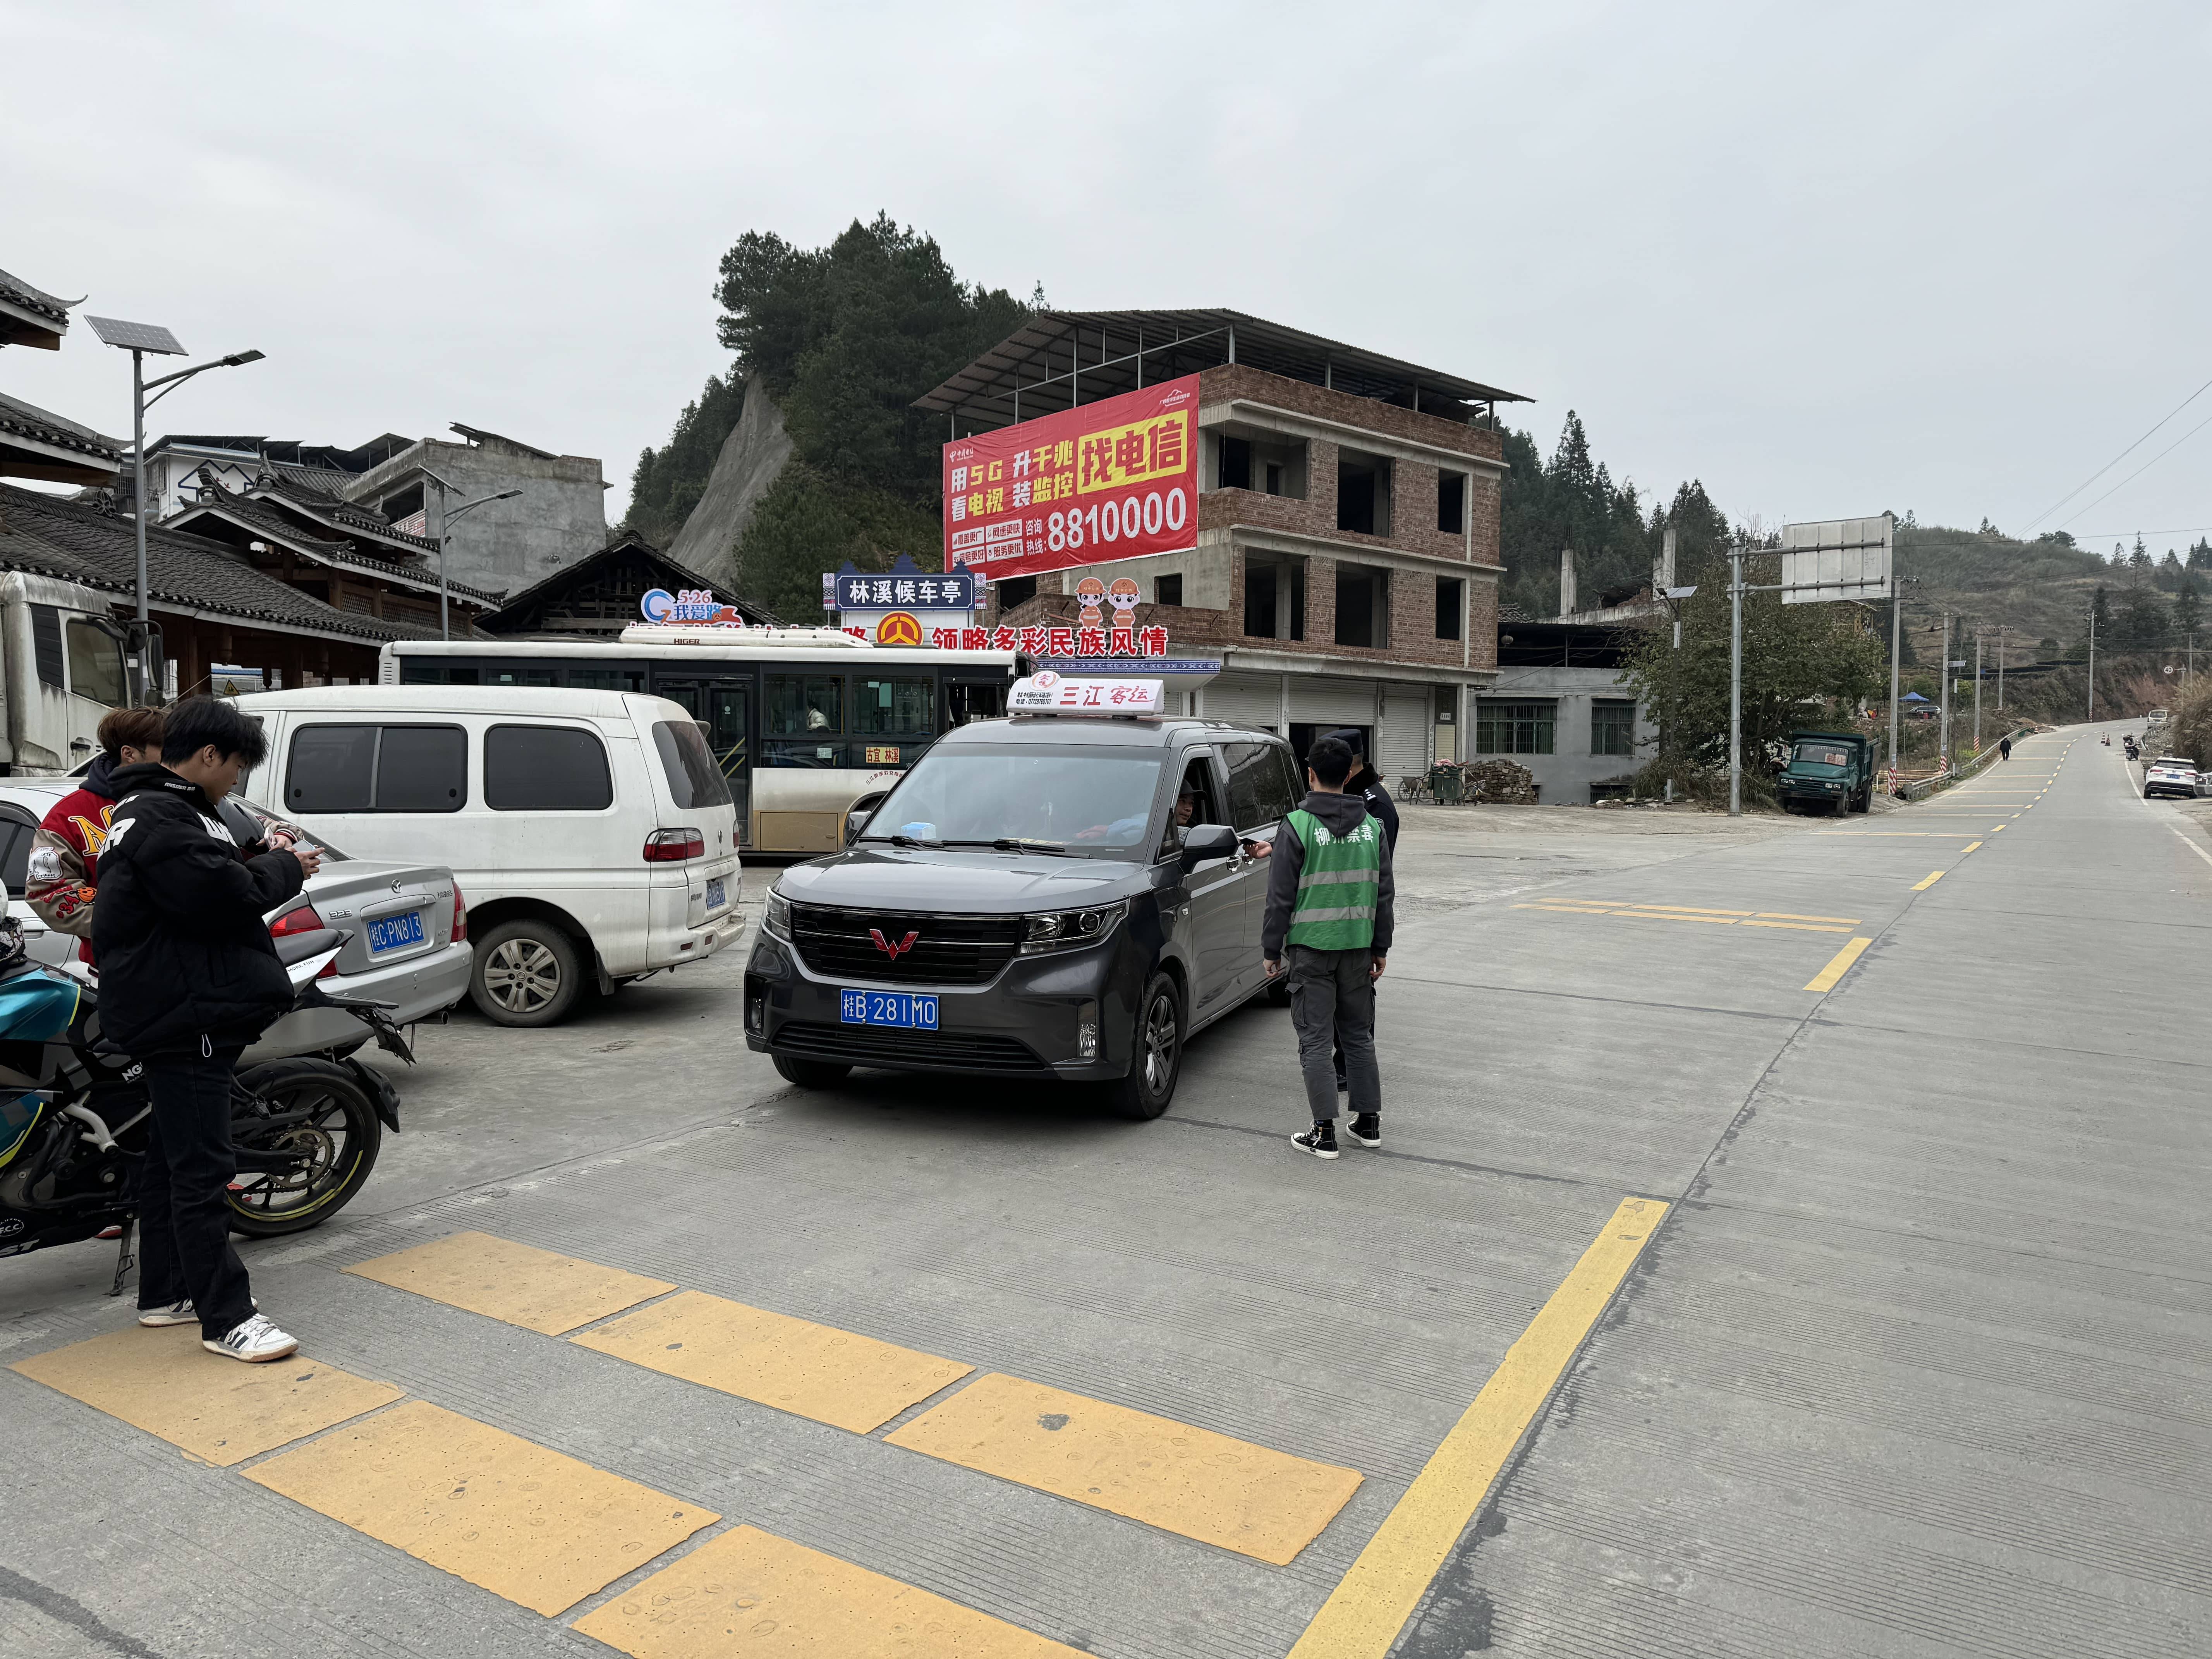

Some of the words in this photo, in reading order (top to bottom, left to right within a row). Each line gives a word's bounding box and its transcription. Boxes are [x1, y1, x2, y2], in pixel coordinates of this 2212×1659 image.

[1013, 440, 1073, 478] 升千兆
[1082, 420, 1183, 488] 找电信
[951, 487, 1003, 522] 看电视
[1012, 471, 1073, 508] 装监控
[1025, 518, 1042, 536] 咨询
[1048, 488, 1186, 551] 8810000
[993, 523, 1020, 538] 网速更快
[959, 549, 984, 562] 信号更好
[993, 543, 1022, 557] 服务更优
[849, 579, 961, 604] 林溪候车亭
[932, 626, 1167, 656] 领略多彩民族风情
[867, 747, 880, 762] 古宜
[885, 747, 899, 763] 林溪
[329, 909, 352, 919] 323
